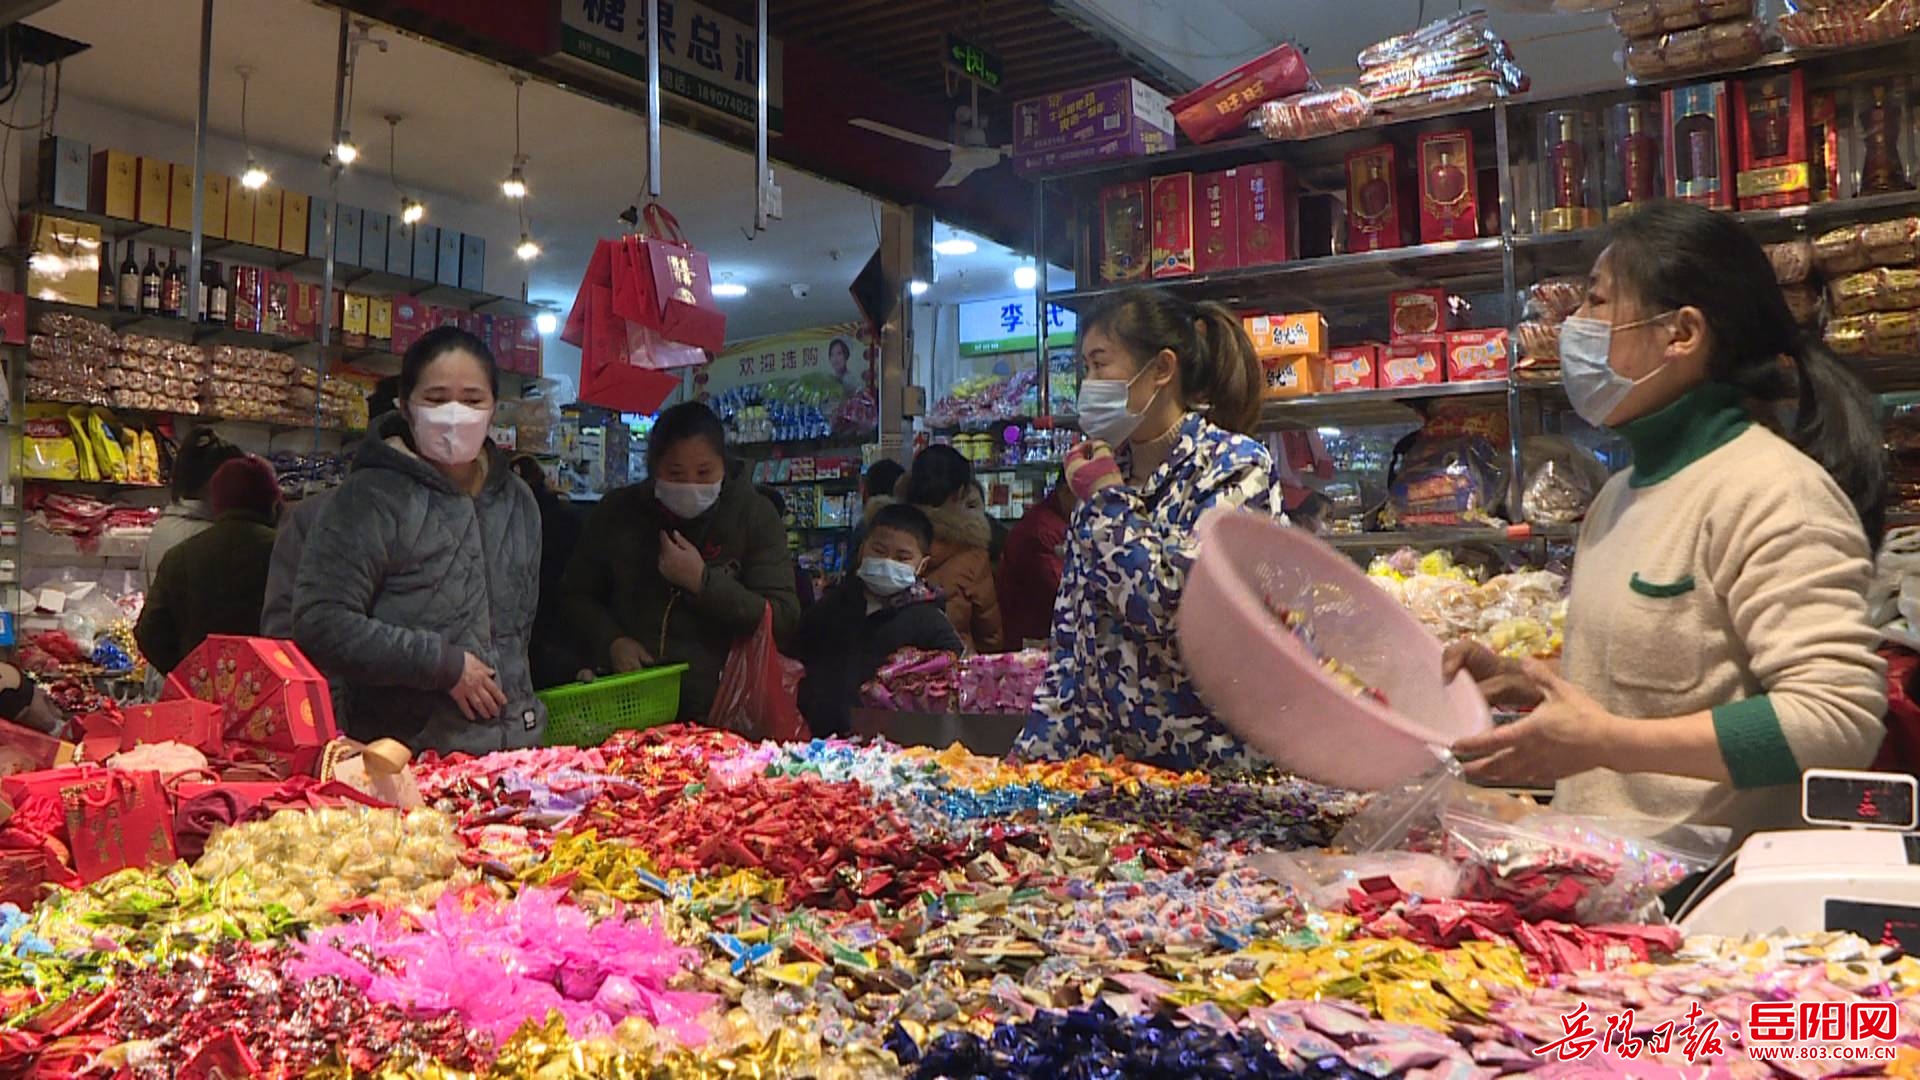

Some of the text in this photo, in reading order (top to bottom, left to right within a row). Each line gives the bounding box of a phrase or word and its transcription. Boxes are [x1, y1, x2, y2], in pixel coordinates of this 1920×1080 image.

[1216, 79, 1265, 116] 旺旺
[738, 347, 819, 377] 欢迎选购
